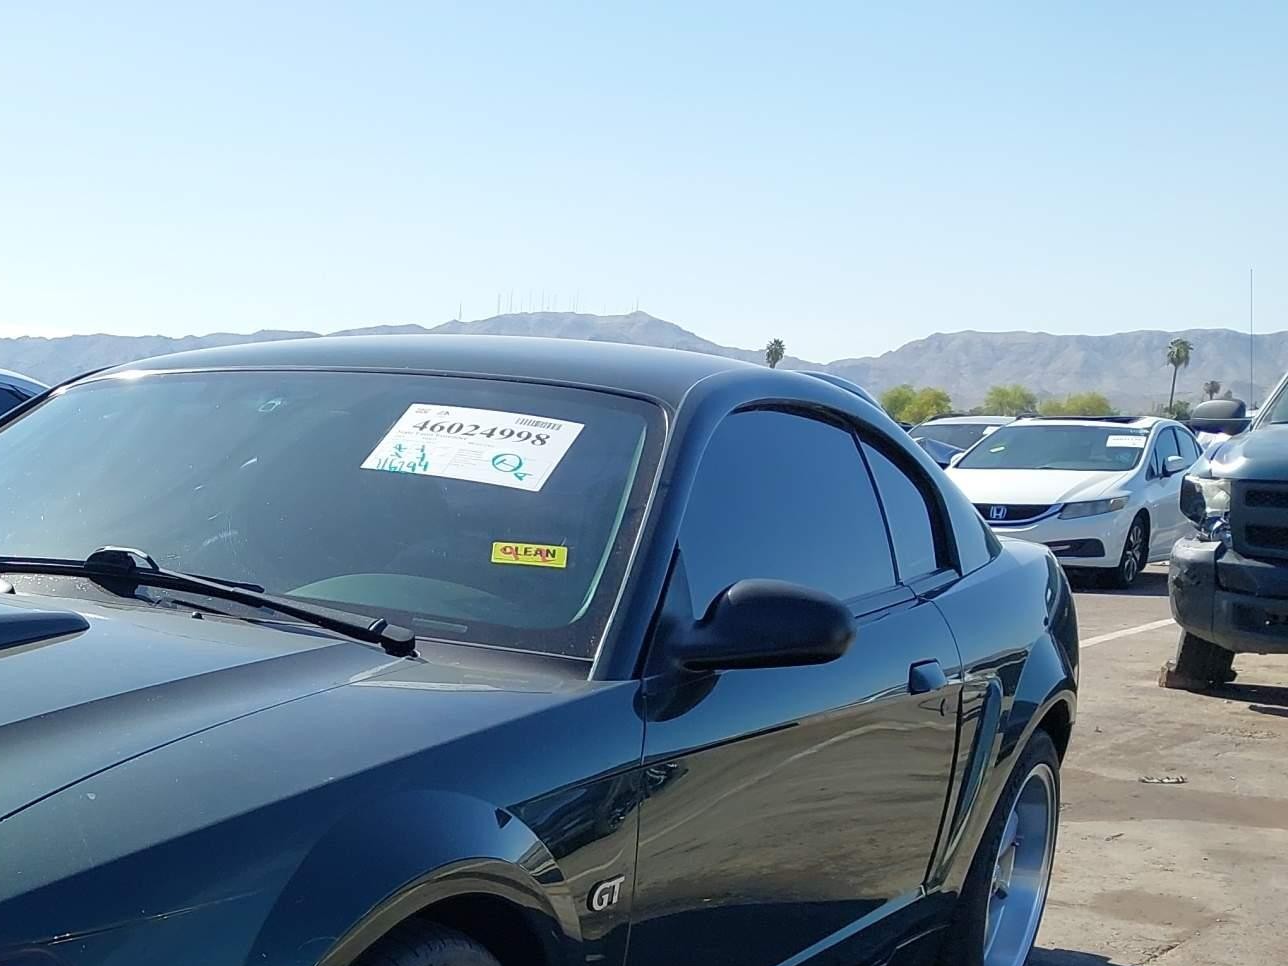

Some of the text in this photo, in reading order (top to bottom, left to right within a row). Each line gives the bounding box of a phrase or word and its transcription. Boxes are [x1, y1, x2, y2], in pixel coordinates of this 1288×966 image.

[412, 418, 551, 447] 46024998
[500, 545, 557, 558] CLEAN
[587, 873, 625, 911] GT
